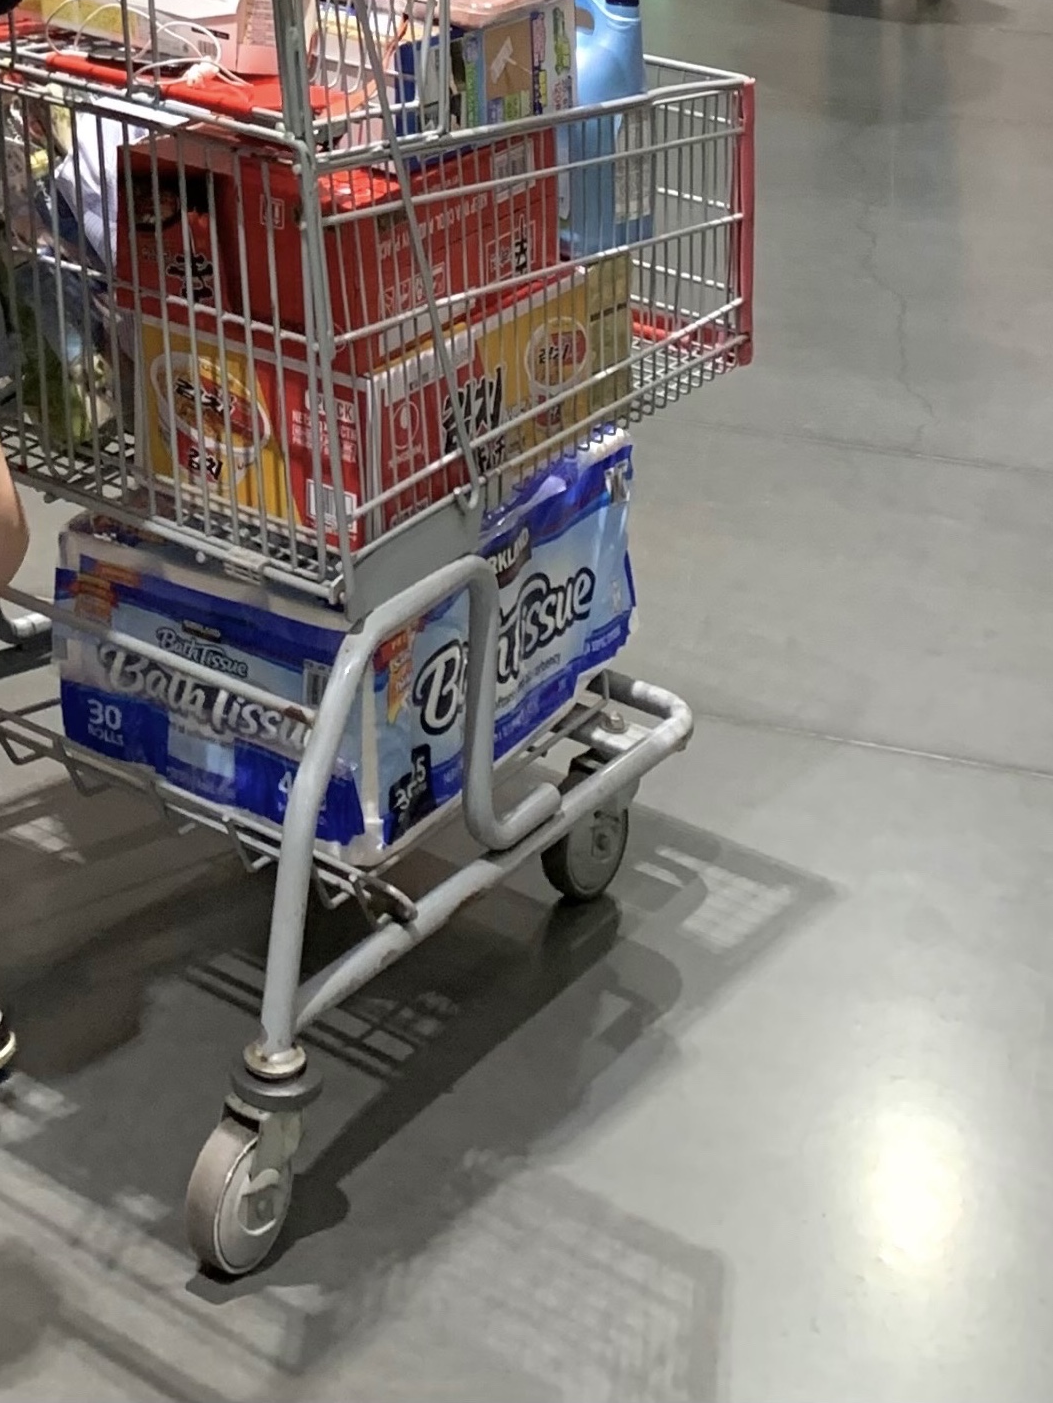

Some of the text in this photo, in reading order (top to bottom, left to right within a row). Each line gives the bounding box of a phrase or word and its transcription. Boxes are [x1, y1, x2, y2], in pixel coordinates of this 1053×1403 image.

[489, 527, 530, 574] RKLAND
[87, 699, 123, 732] 30
[88, 724, 124, 747] ROLLS
[210, 687, 318, 749] Tissu
